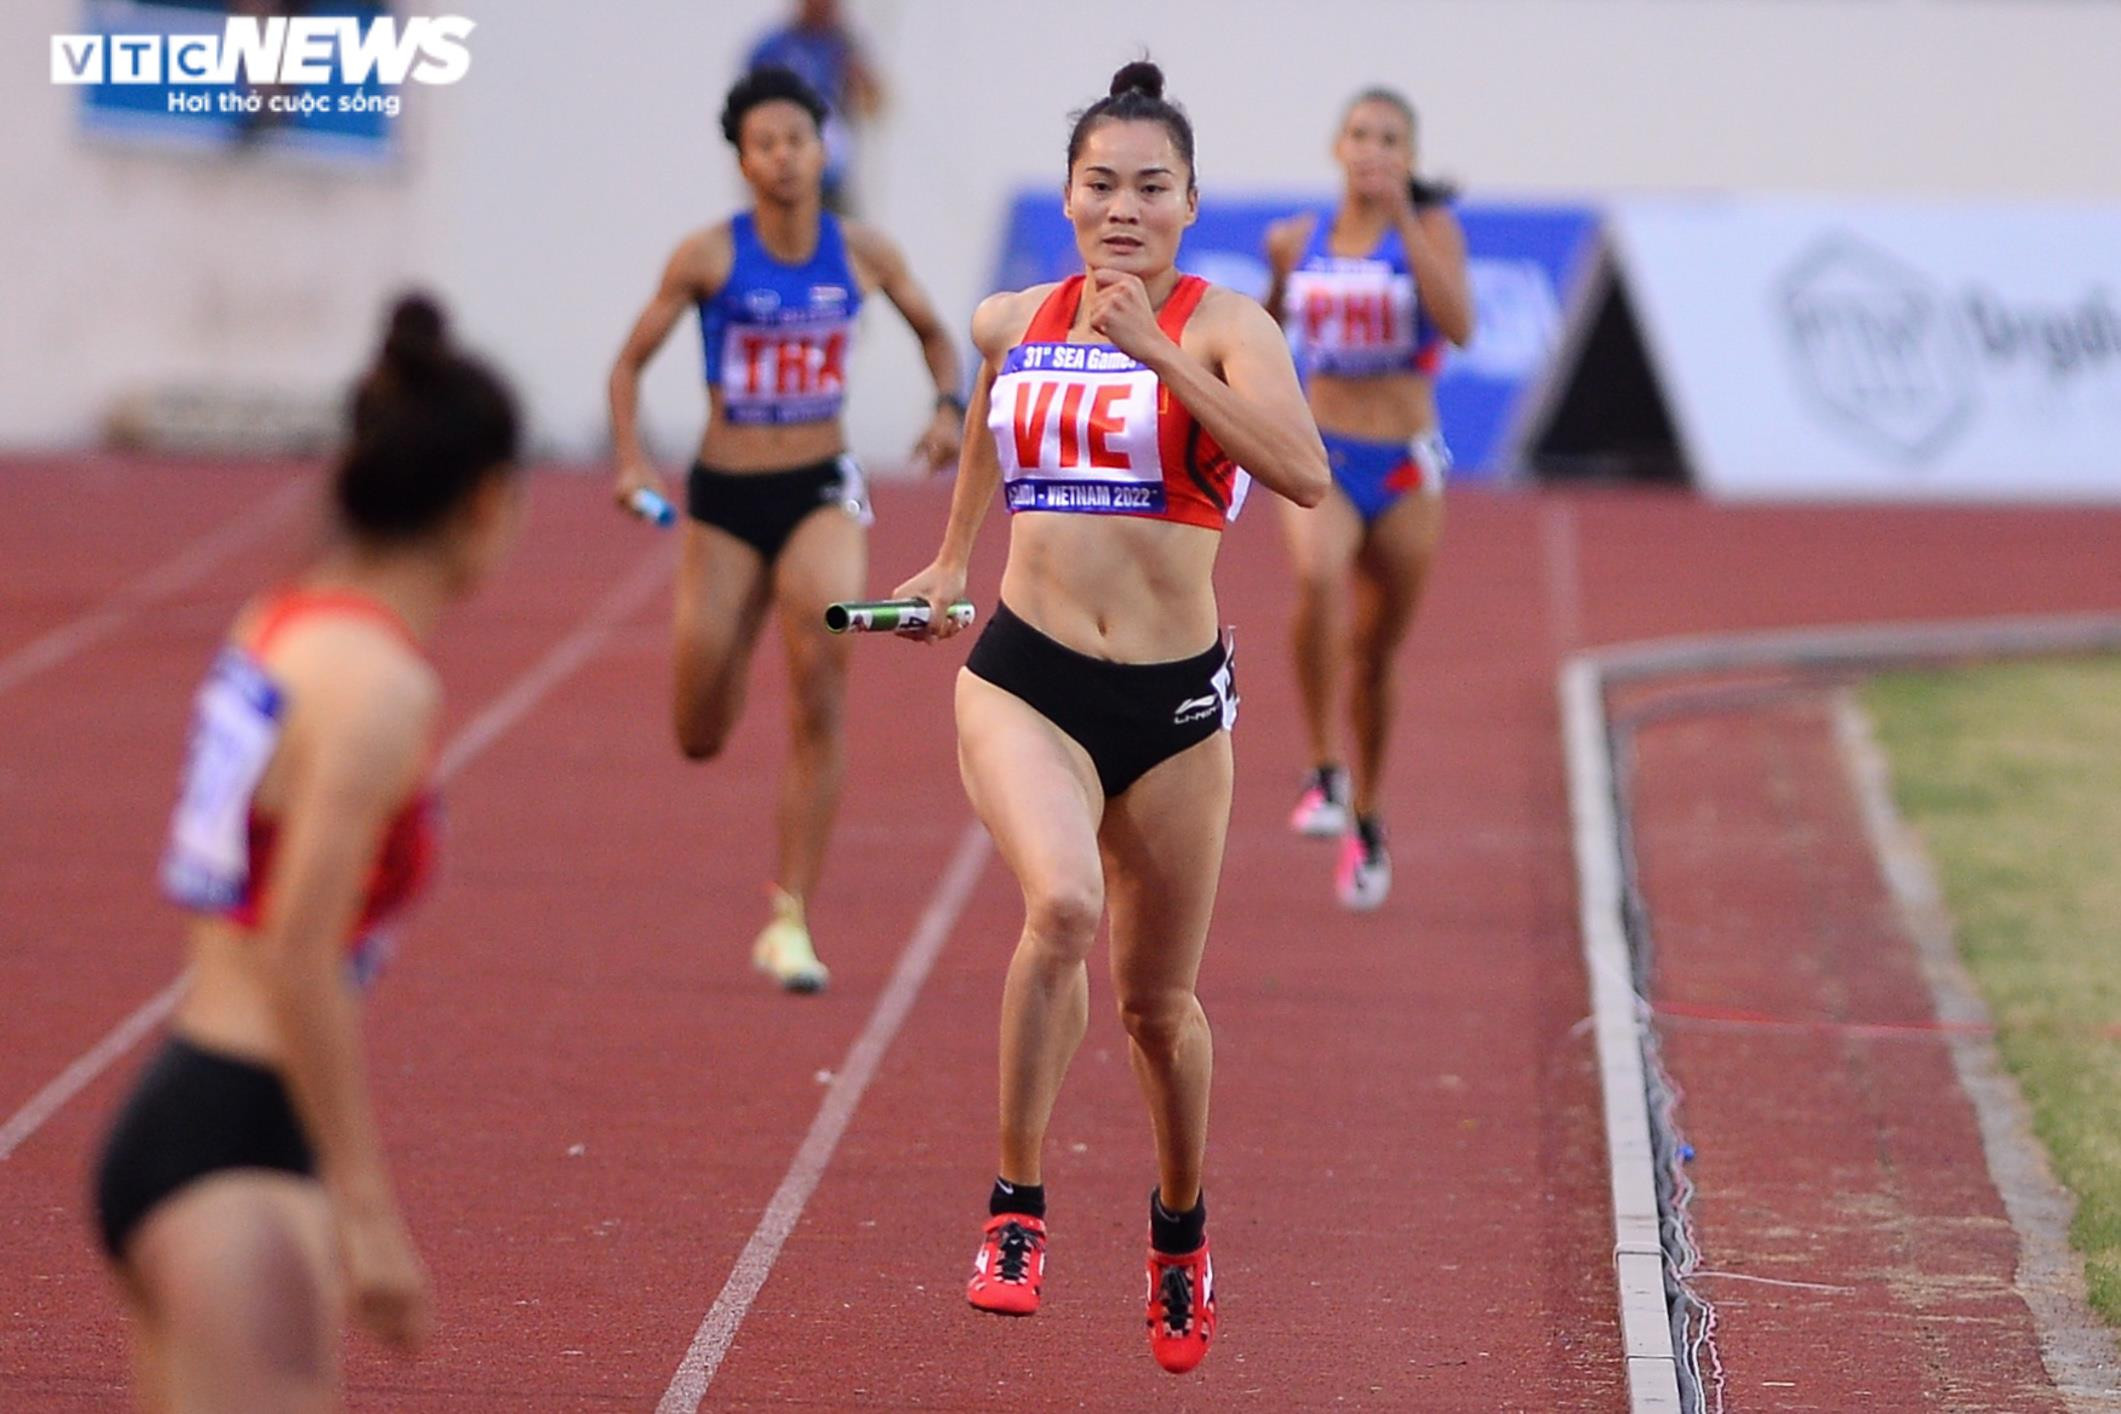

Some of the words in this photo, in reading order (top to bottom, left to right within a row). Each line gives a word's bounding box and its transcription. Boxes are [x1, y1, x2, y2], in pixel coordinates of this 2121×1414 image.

[1306, 288, 1395, 345] PHI
[742, 331, 845, 394] THA
[1052, 346, 1085, 369] SEA
[1013, 381, 1132, 469] VIE
[1047, 485, 1111, 506] VIETNAM
[1113, 487, 1151, 508] 2022
